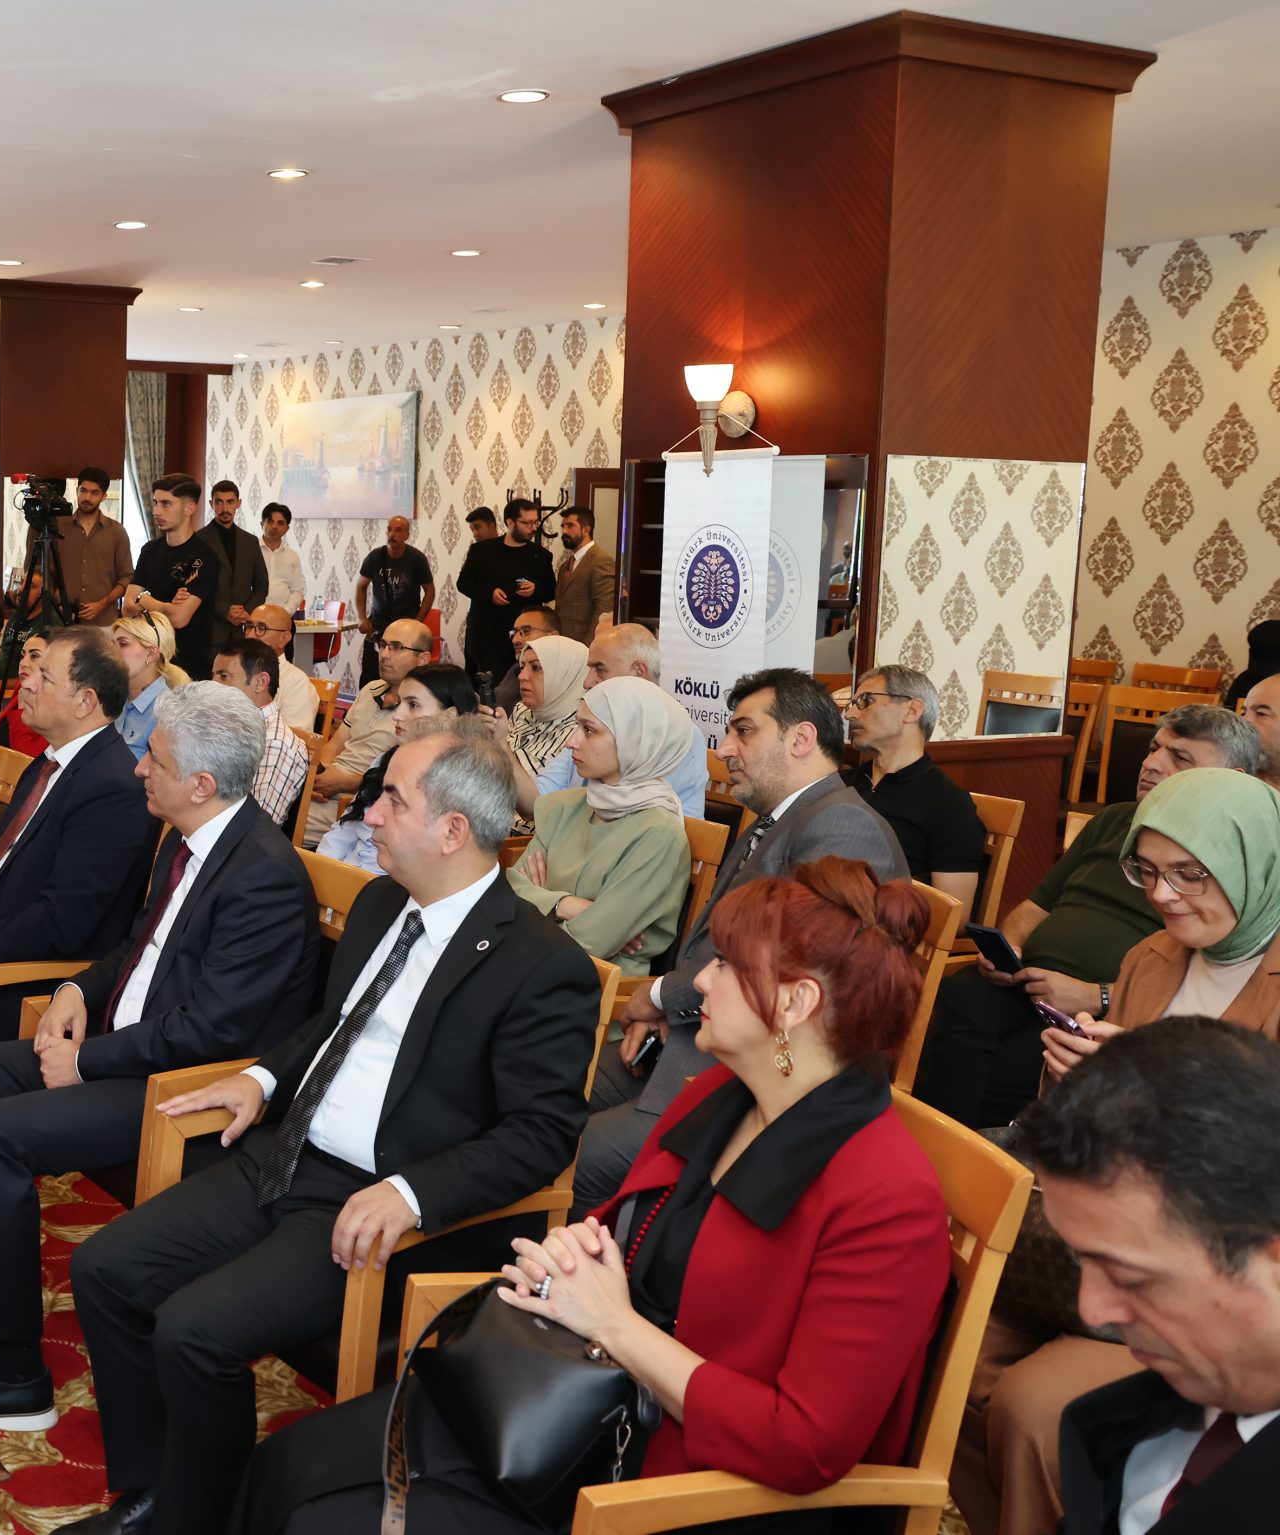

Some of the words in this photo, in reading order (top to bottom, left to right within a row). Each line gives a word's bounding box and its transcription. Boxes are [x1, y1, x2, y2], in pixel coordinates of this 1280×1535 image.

[680, 537, 704, 578] Atatürk
[706, 530, 750, 582] Üniversitesi
[678, 597, 702, 638] Atatürk
[705, 602, 748, 642] University
[674, 677, 720, 700] KÖKLÜ
[676, 699, 733, 726] iversit
